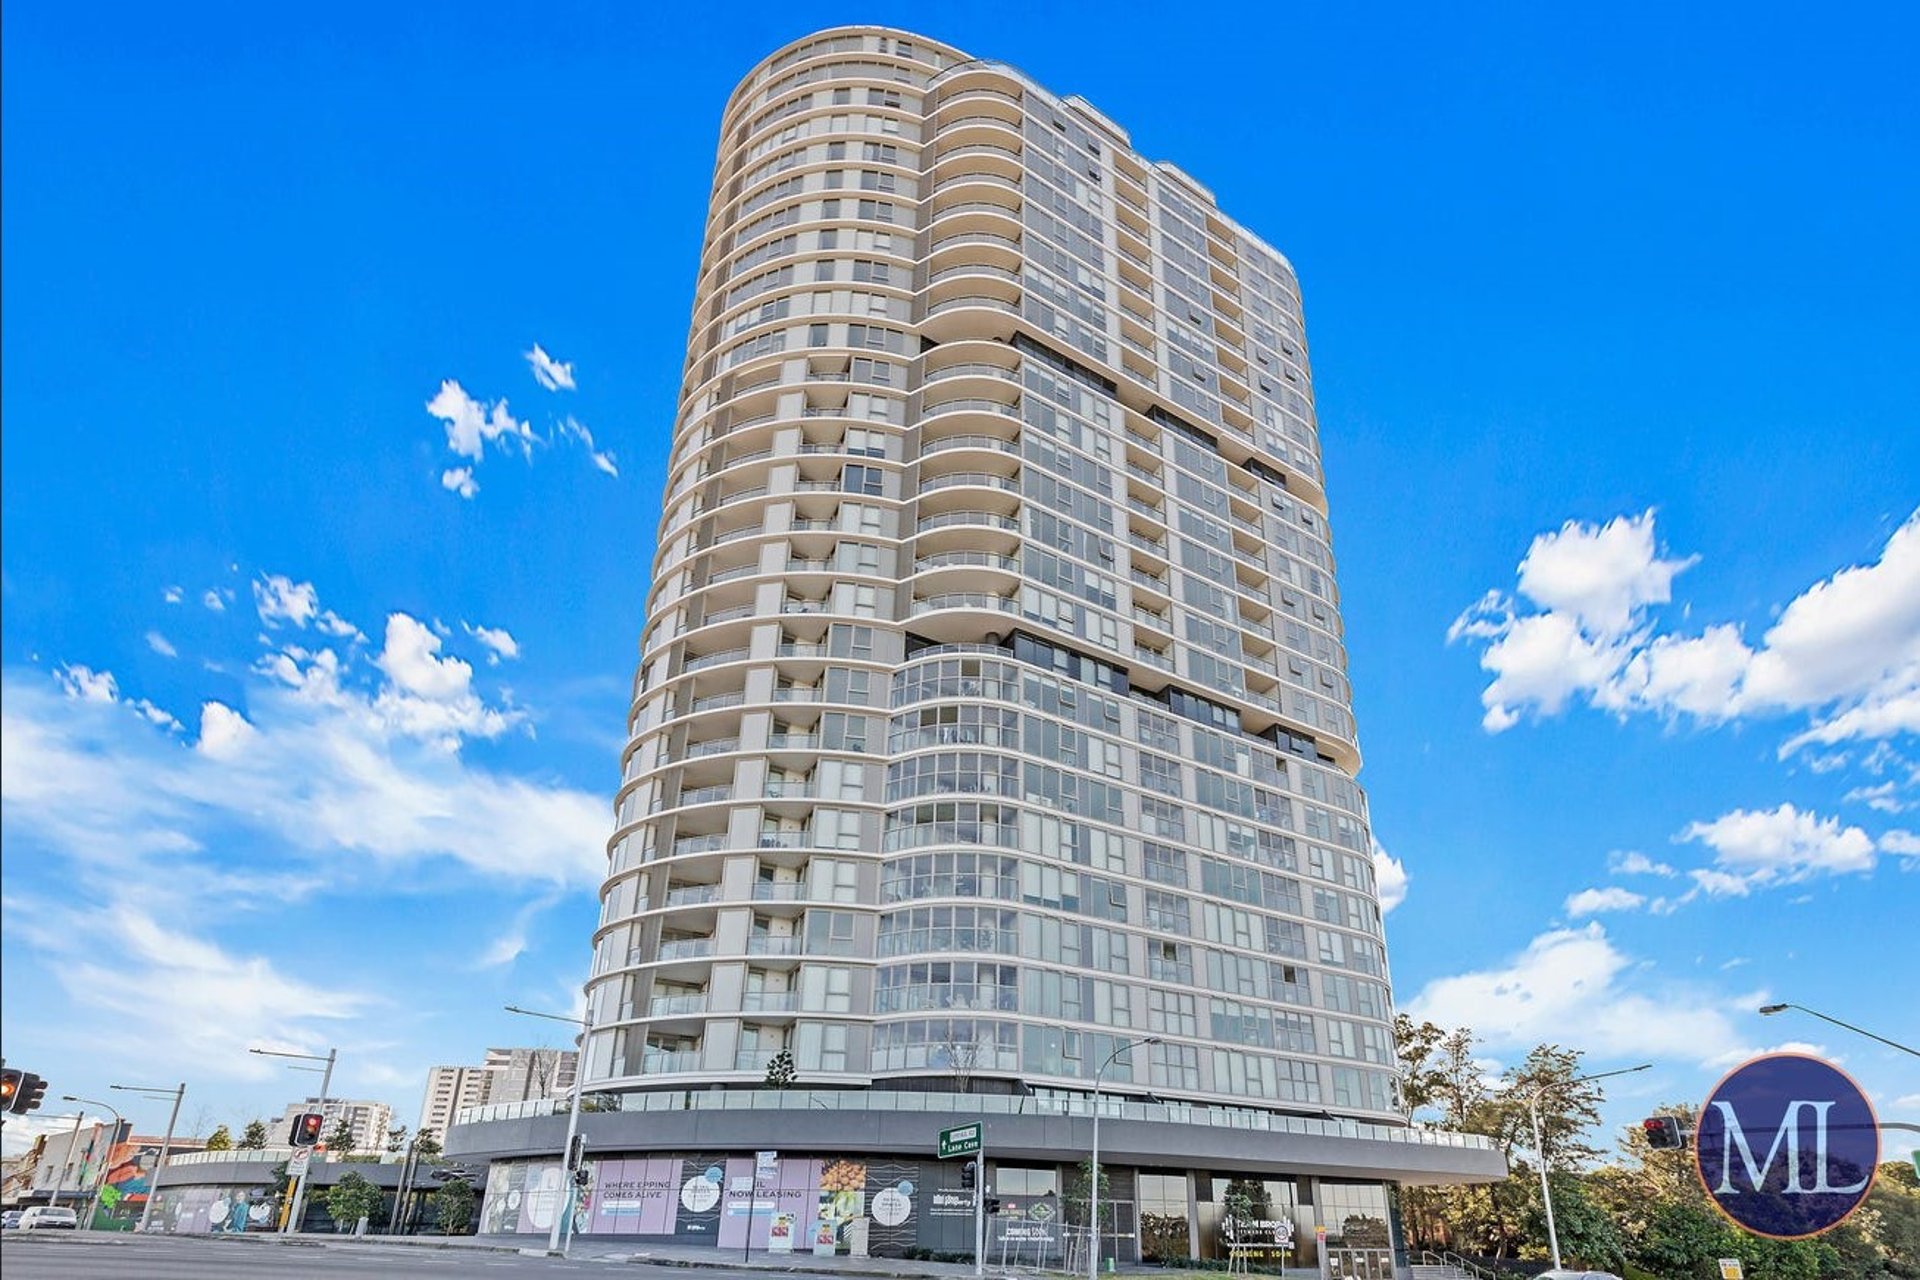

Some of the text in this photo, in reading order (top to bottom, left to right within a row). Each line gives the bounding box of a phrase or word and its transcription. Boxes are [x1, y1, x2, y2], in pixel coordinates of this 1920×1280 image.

[947, 1143, 963, 1153] Lane
[604, 1181, 634, 1189] WHERE
[603, 1191, 663, 1199] COMES ALIVE
[728, 1190, 802, 1199] NOW LEASING
